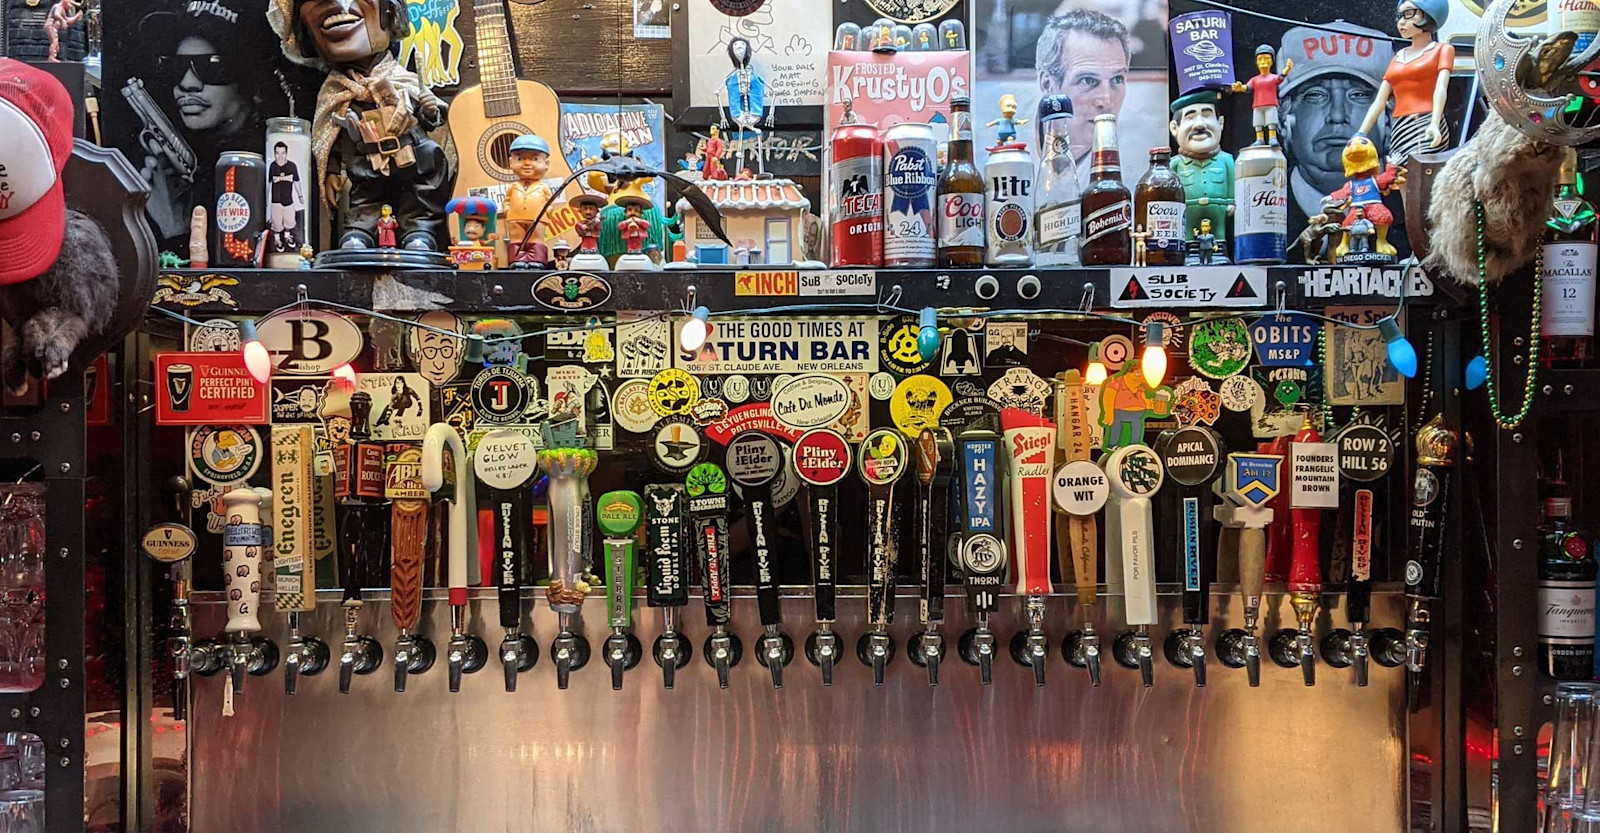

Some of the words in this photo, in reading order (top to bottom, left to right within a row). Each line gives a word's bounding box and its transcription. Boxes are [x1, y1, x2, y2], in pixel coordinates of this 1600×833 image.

[1176, 17, 1227, 34] SATURN
[1190, 30, 1218, 41] BAR
[1303, 35, 1374, 60] PUTO
[795, 63, 815, 71] PALS
[855, 62, 896, 75] FROSTED
[772, 79, 819, 87] GROENING
[832, 65, 967, 112] KrustyO's
[794, 88, 826, 96] SIMPSON
[563, 110, 649, 138] ADIOACTIVE
[894, 154, 925, 171] Pabst
[885, 172, 903, 186] Blue
[904, 172, 935, 186] Ribbon
[992, 175, 1031, 202] Lite
[231, 194, 247, 207] BEER
[229, 208, 249, 216] WIRE
[1149, 204, 1178, 216] Coors
[900, 221, 921, 236] 24
[1044, 219, 1066, 231] HIGH
[1087, 213, 1123, 234] Bohemia
[1150, 230, 1178, 238] BEER
[1344, 254, 1364, 262] DIEGO
[1148, 274, 1188, 284] SUB
[1543, 268, 1593, 277] MACALLAN
[755, 272, 796, 294] INCH
[1304, 266, 1434, 298] HEARTACHES
[1562, 288, 1577, 299] 12
[1274, 314, 1293, 323] The
[717, 322, 745, 339] THE
[750, 322, 792, 339] GOOD
[797, 321, 844, 338] TIMES
[847, 321, 866, 337] AT
[1254, 326, 1311, 343] OBITS
[680, 341, 799, 361] SATURN
[811, 341, 870, 361] BAR
[1268, 349, 1300, 360] MS&P
[708, 363, 722, 371] ST.
[723, 363, 761, 371] CLAUDE
[761, 363, 783, 371] AVE.
[797, 363, 820, 371] NEW
[820, 362, 864, 371] ORLEANS
[200, 377, 235, 387] PERFECT
[235, 377, 254, 387] PINT
[473, 370, 491, 389] TOROS
[491, 367, 501, 375] DE
[501, 366, 526, 389] TIJUANA
[649, 369, 697, 395] Mikkeller
[807, 377, 833, 386] Beignets
[199, 386, 255, 399] CERTIFIED
[988, 374, 1052, 399] STRANGE
[800, 397, 813, 411] Du
[814, 389, 844, 408] Monde
[943, 398, 973, 416] BUCKNER
[973, 396, 1001, 413] BUILDING
[729, 407, 773, 425] YUENGLING
[810, 413, 833, 425] Orleans
[1070, 398, 1081, 437] HANGAR
[486, 442, 527, 453] VELVET
[735, 445, 766, 456] Pliny
[1013, 432, 1051, 458] Stiegl
[1073, 443, 1083, 453] 24
[1177, 442, 1204, 453] APICAL
[1343, 437, 1376, 452] ROW
[1378, 439, 1387, 452] 2
[483, 452, 519, 463] GLOW
[802, 446, 837, 459] Pliny
[1296, 455, 1334, 463] FOUNDERS
[741, 455, 773, 465] Elder
[806, 458, 843, 469] Elder
[1167, 454, 1214, 467] DOMINANCE
[1341, 456, 1368, 470] HILL
[1371, 457, 1388, 471] 56
[1017, 465, 1049, 476] Radler
[1295, 465, 1335, 473] FRANGELIC
[973, 459, 986, 514] HAZY
[1058, 476, 1104, 487] ORANGE
[695, 497, 726, 505] TOWNS
[1073, 490, 1094, 501] WIT
[1412, 509, 1425, 518] OLD
[501, 502, 512, 548] RUSSIAN
[652, 517, 679, 525] STONE
[752, 501, 766, 547] RUSSIAN
[818, 499, 829, 543] RUSSIAN
[874, 500, 885, 545] RUSSIAN
[971, 517, 991, 527] IPA
[1187, 502, 1197, 543] RUSSIAN
[654, 526, 671, 556] Poem
[671, 532, 679, 547] IPA
[706, 533, 716, 551] THE
[502, 551, 515, 585] RIVER
[757, 549, 771, 583] RIVER
[819, 546, 831, 580] RIVER
[873, 547, 886, 581] RIVER
[1188, 545, 1198, 586] RIVER
[655, 558, 673, 595] Liquid
[672, 551, 680, 589] DOUBLE
[709, 570, 719, 597] APPLE
[968, 576, 999, 585] THORN
[240, 602, 249, 614] G
